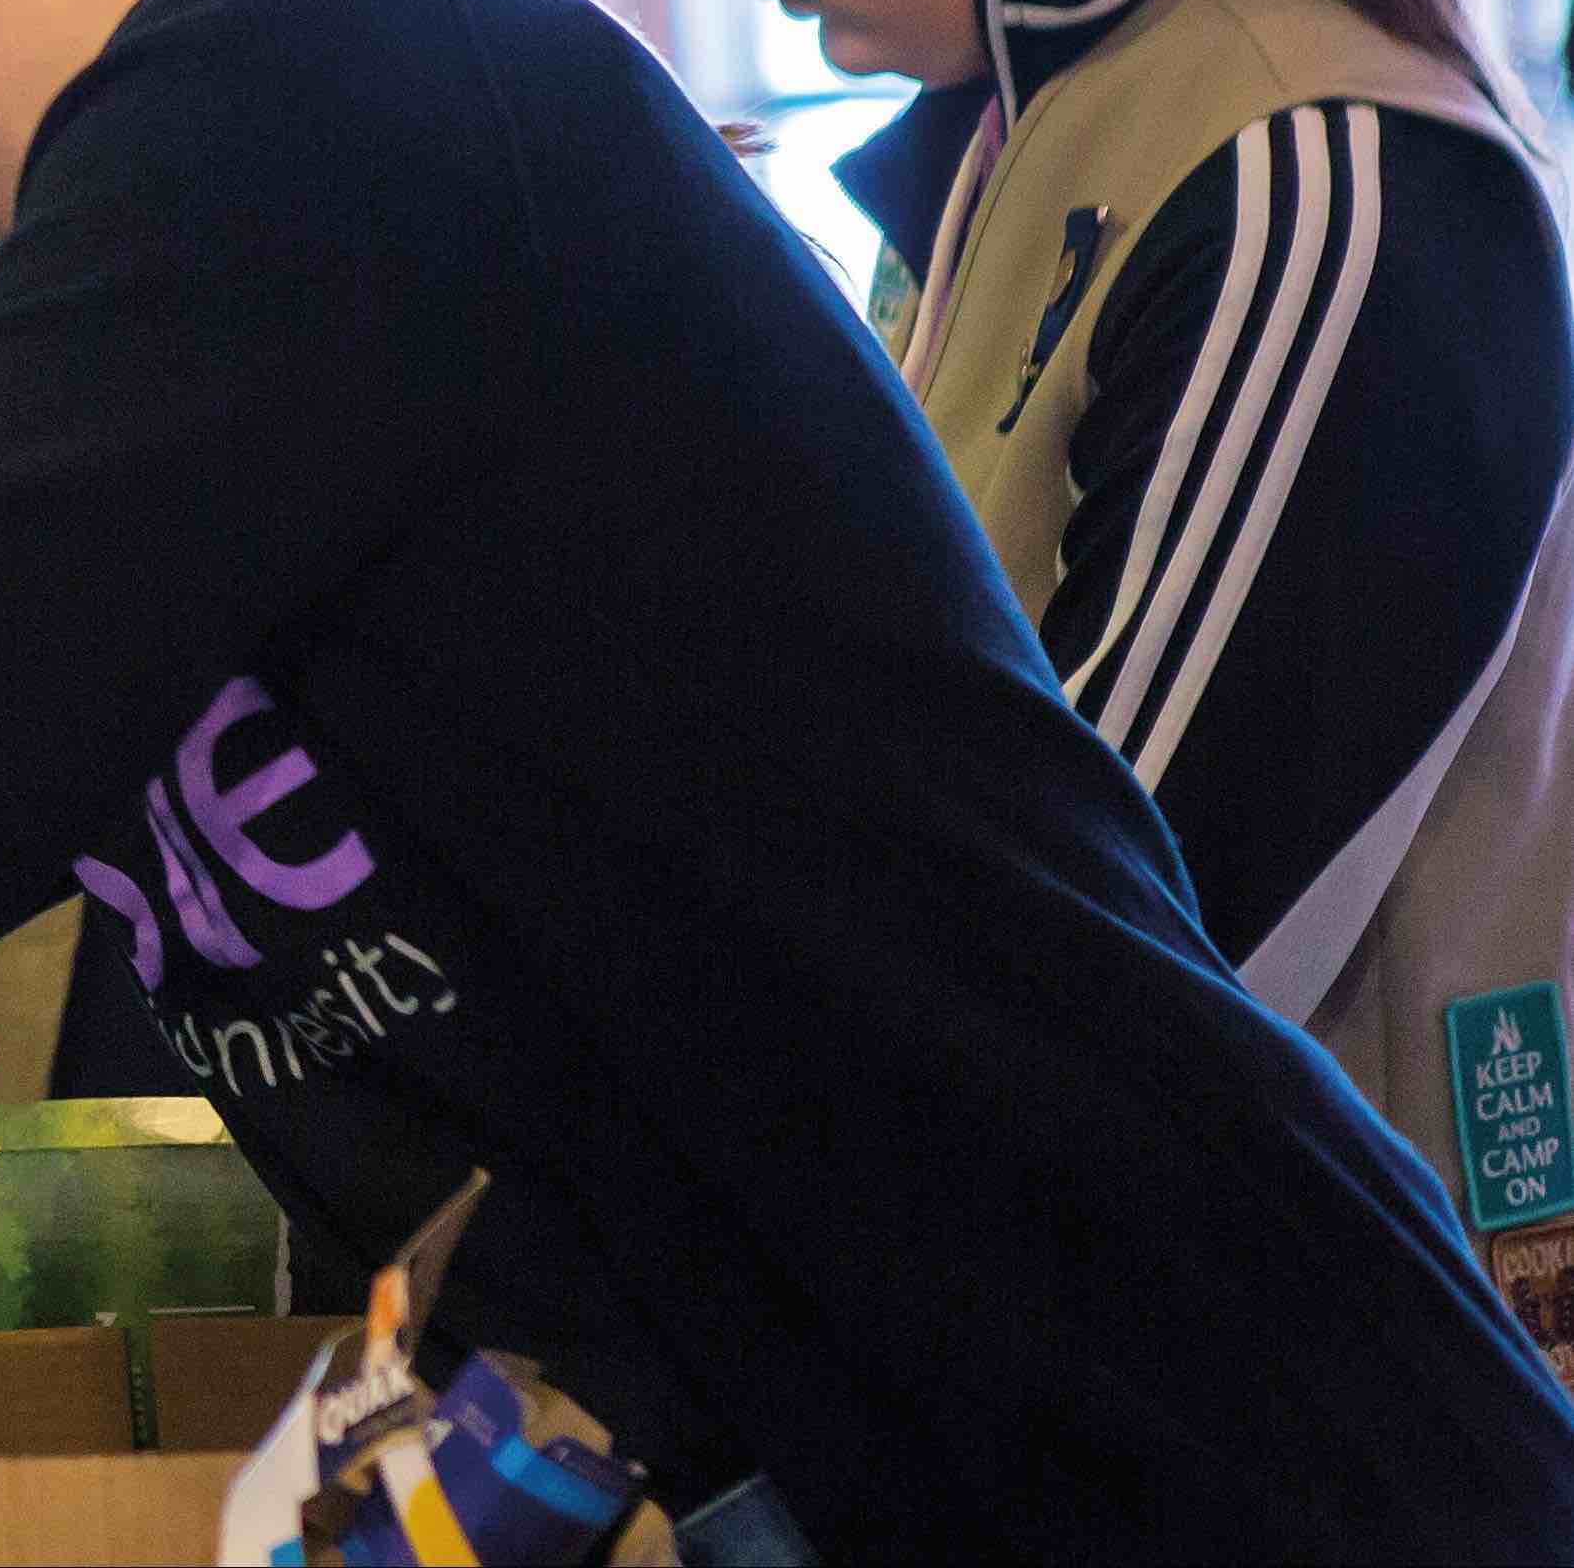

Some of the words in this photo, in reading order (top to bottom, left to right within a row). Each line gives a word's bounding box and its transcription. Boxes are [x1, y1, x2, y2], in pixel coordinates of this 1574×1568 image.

[1475, 1050, 1543, 1089] KEEP
[1475, 1082, 1555, 1121] CALM
[1497, 1115, 1541, 1143] AND
[1482, 1137, 1560, 1179] CAMP
[1506, 1173, 1547, 1207] ON
